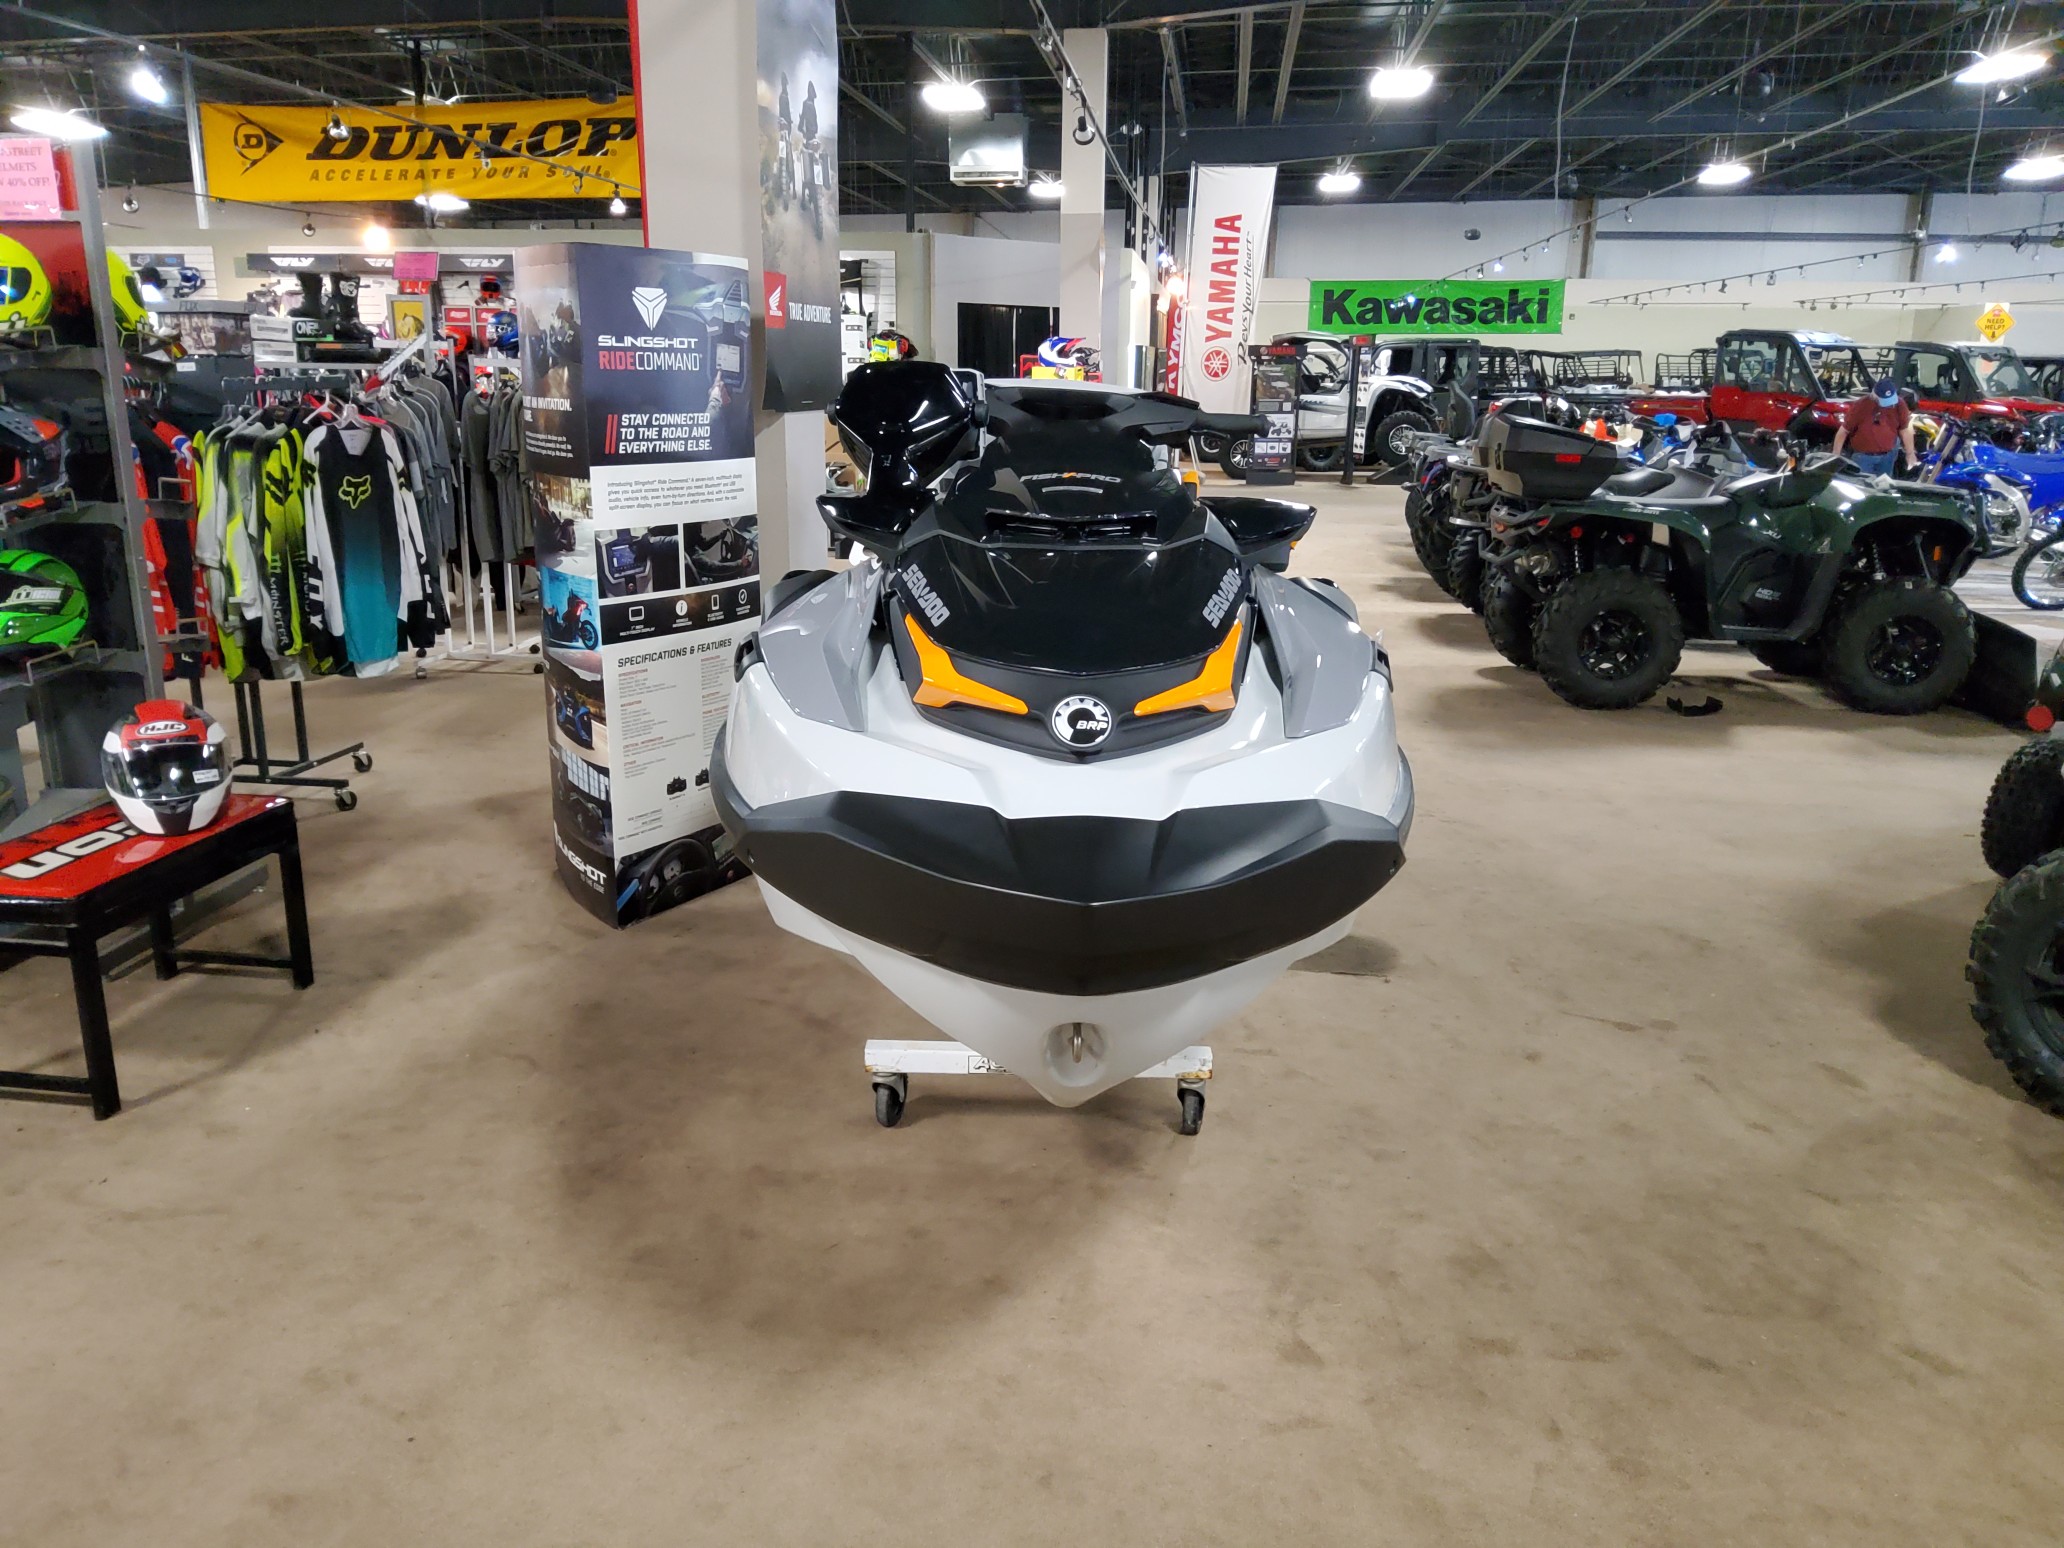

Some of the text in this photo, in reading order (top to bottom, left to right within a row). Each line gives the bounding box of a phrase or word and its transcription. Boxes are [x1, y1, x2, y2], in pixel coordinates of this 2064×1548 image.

[306, 117, 637, 160] DUNLOP
[309, 168, 455, 181] ACCELERATE
[472, 166, 530, 179] YOUR
[1205, 214, 1242, 343] YAMAHA
[789, 302, 832, 324] TRUE ADVENTURE
[1322, 288, 1550, 325] Kawasaki
[598, 335, 698, 349] SLINGSHOT
[1237, 315, 1249, 366] Revs
[538, 397, 572, 411] INVITATION.
[621, 413, 710, 426] STAY CONNECTED
[620, 426, 711, 440] TO THE ROAD AND
[619, 439, 713, 454] EVERYTHING ELSE.
[618, 647, 688, 668] SPECIFICATIONS
[689, 647, 695, 655] &
[697, 638, 732, 654] FEATURES
[144, 723, 183, 733] HJC
[1076, 720, 1108, 731] BRP
